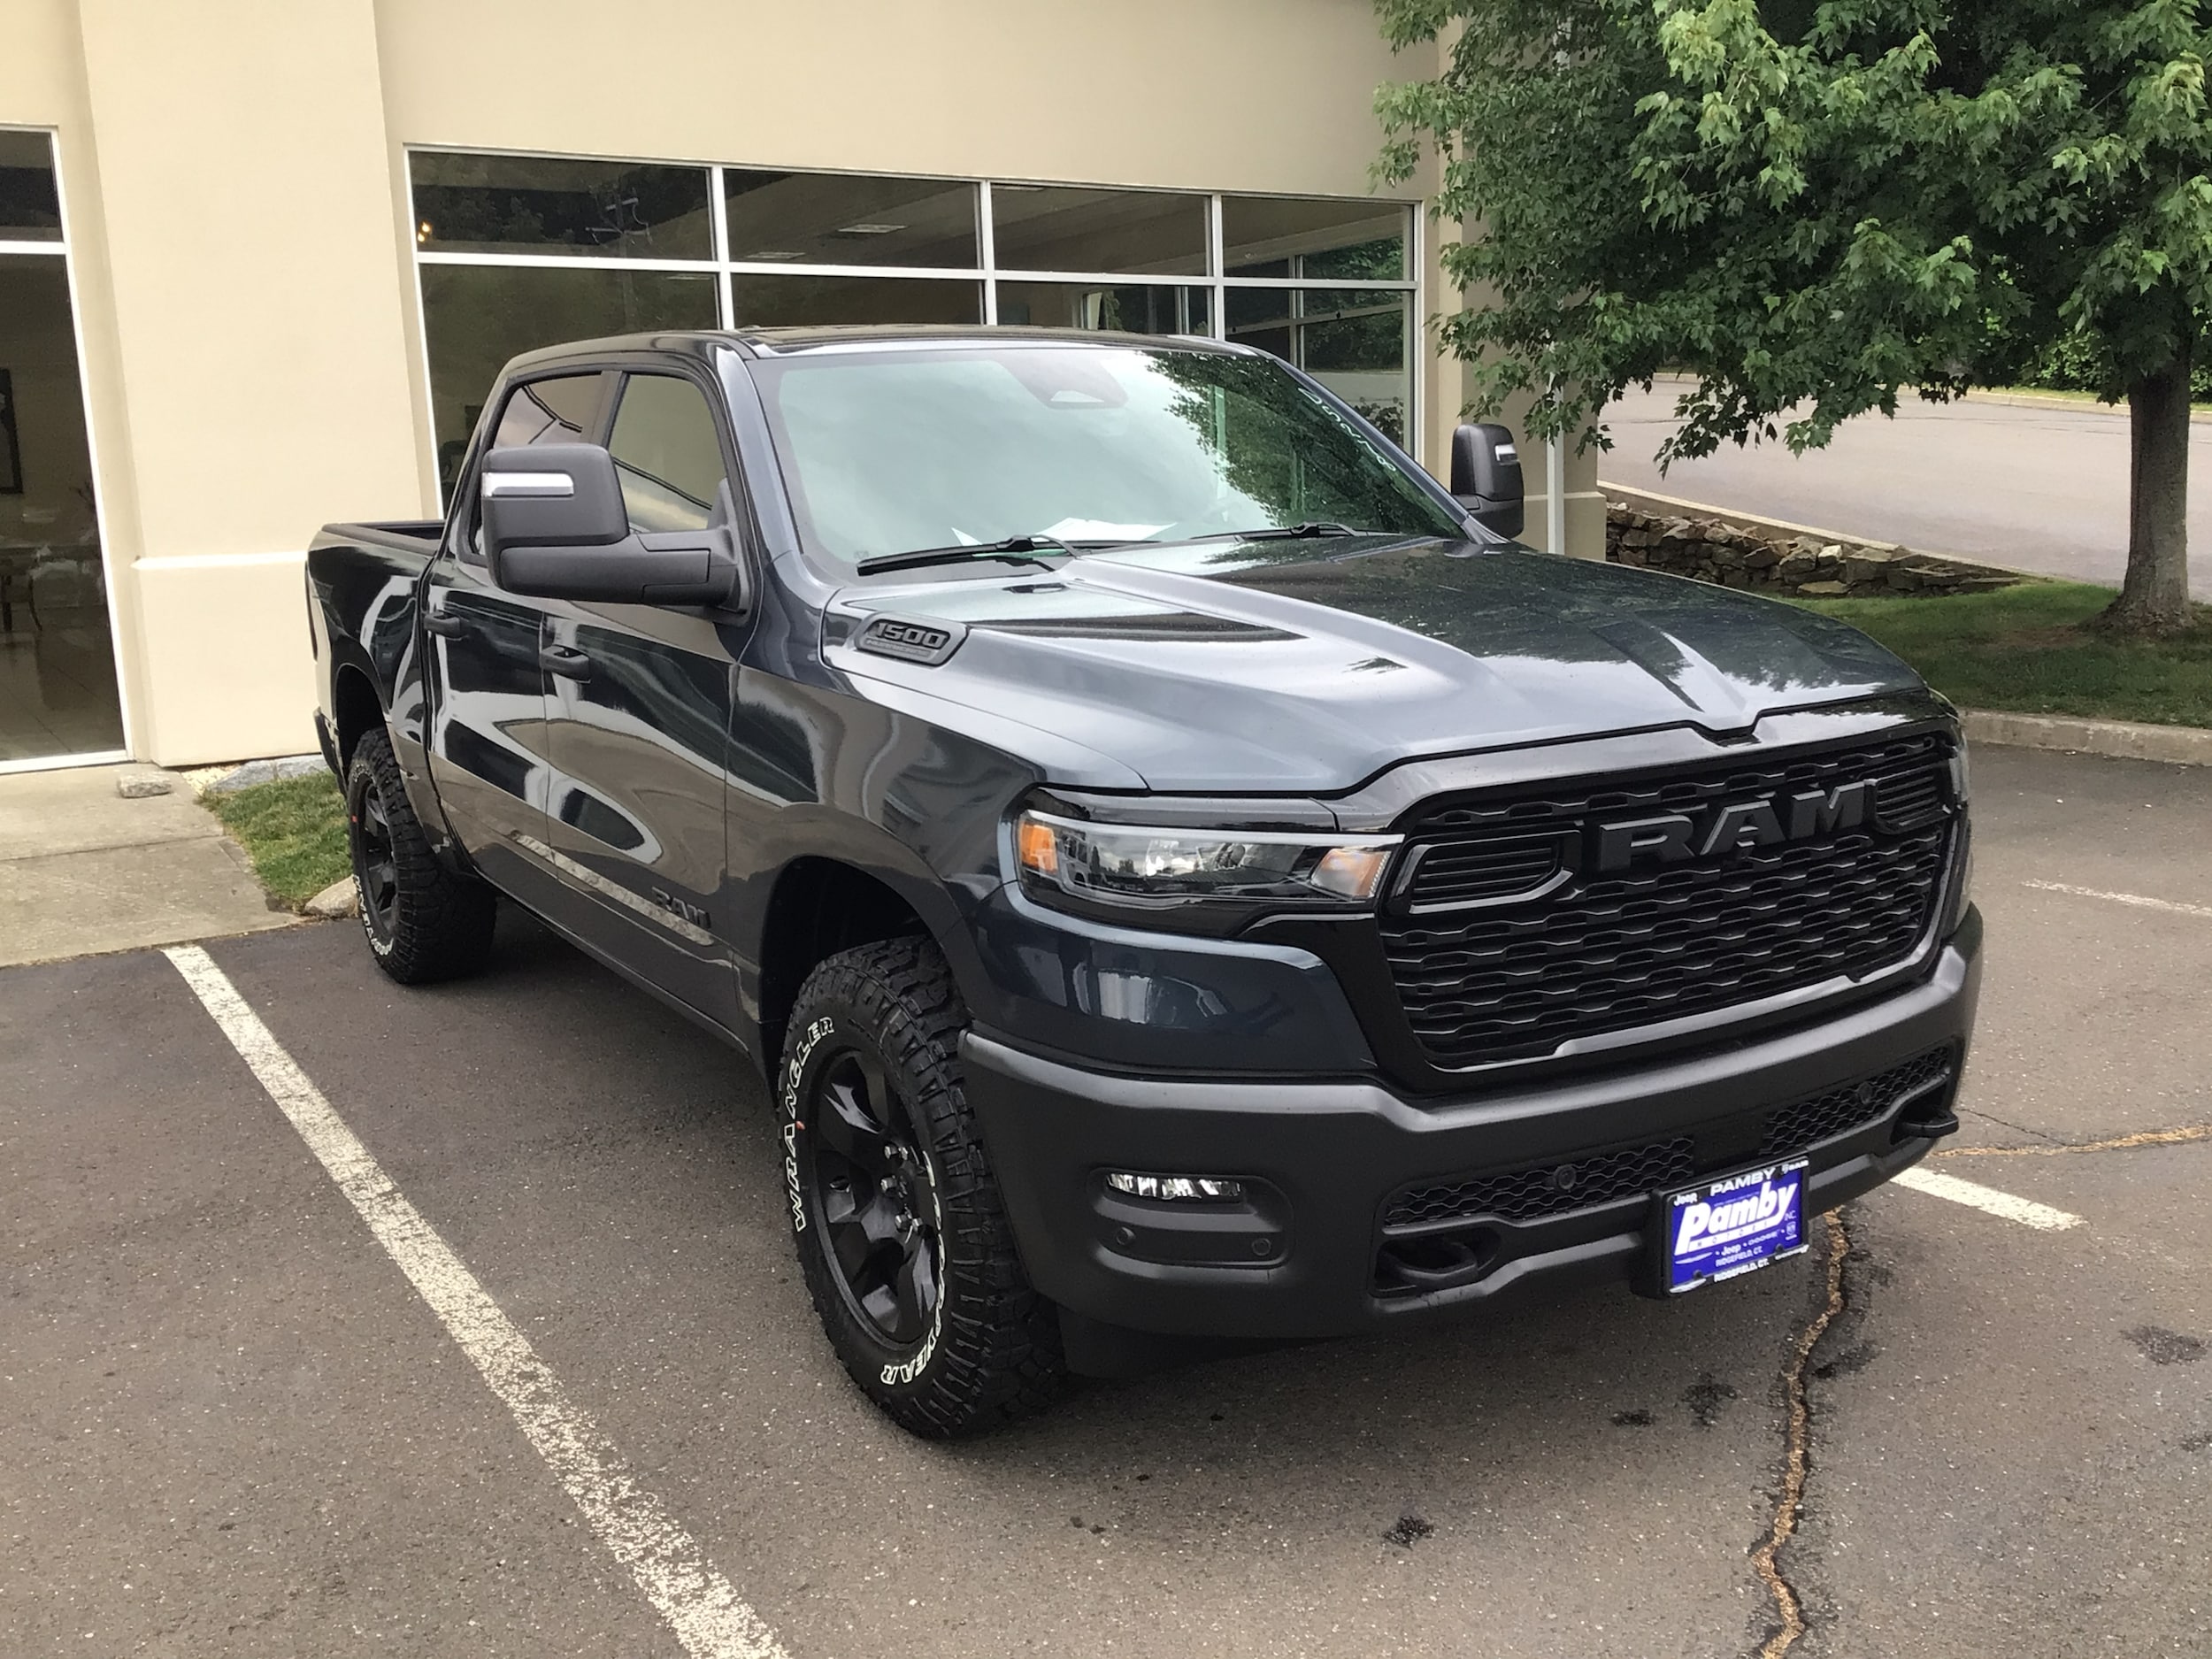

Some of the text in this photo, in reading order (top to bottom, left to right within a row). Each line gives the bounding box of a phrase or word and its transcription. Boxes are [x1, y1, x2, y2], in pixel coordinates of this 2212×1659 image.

[876, 622, 948, 649] 1500
[1601, 781, 1865, 872] RAM
[651, 887, 710, 928] RAM
[784, 1016, 834, 1232] WRANGLER
[1709, 1167, 1776, 1196] PAMBY
[1674, 1181, 1798, 1256] Pamby
[1721, 1241, 1741, 1256] Jeep
